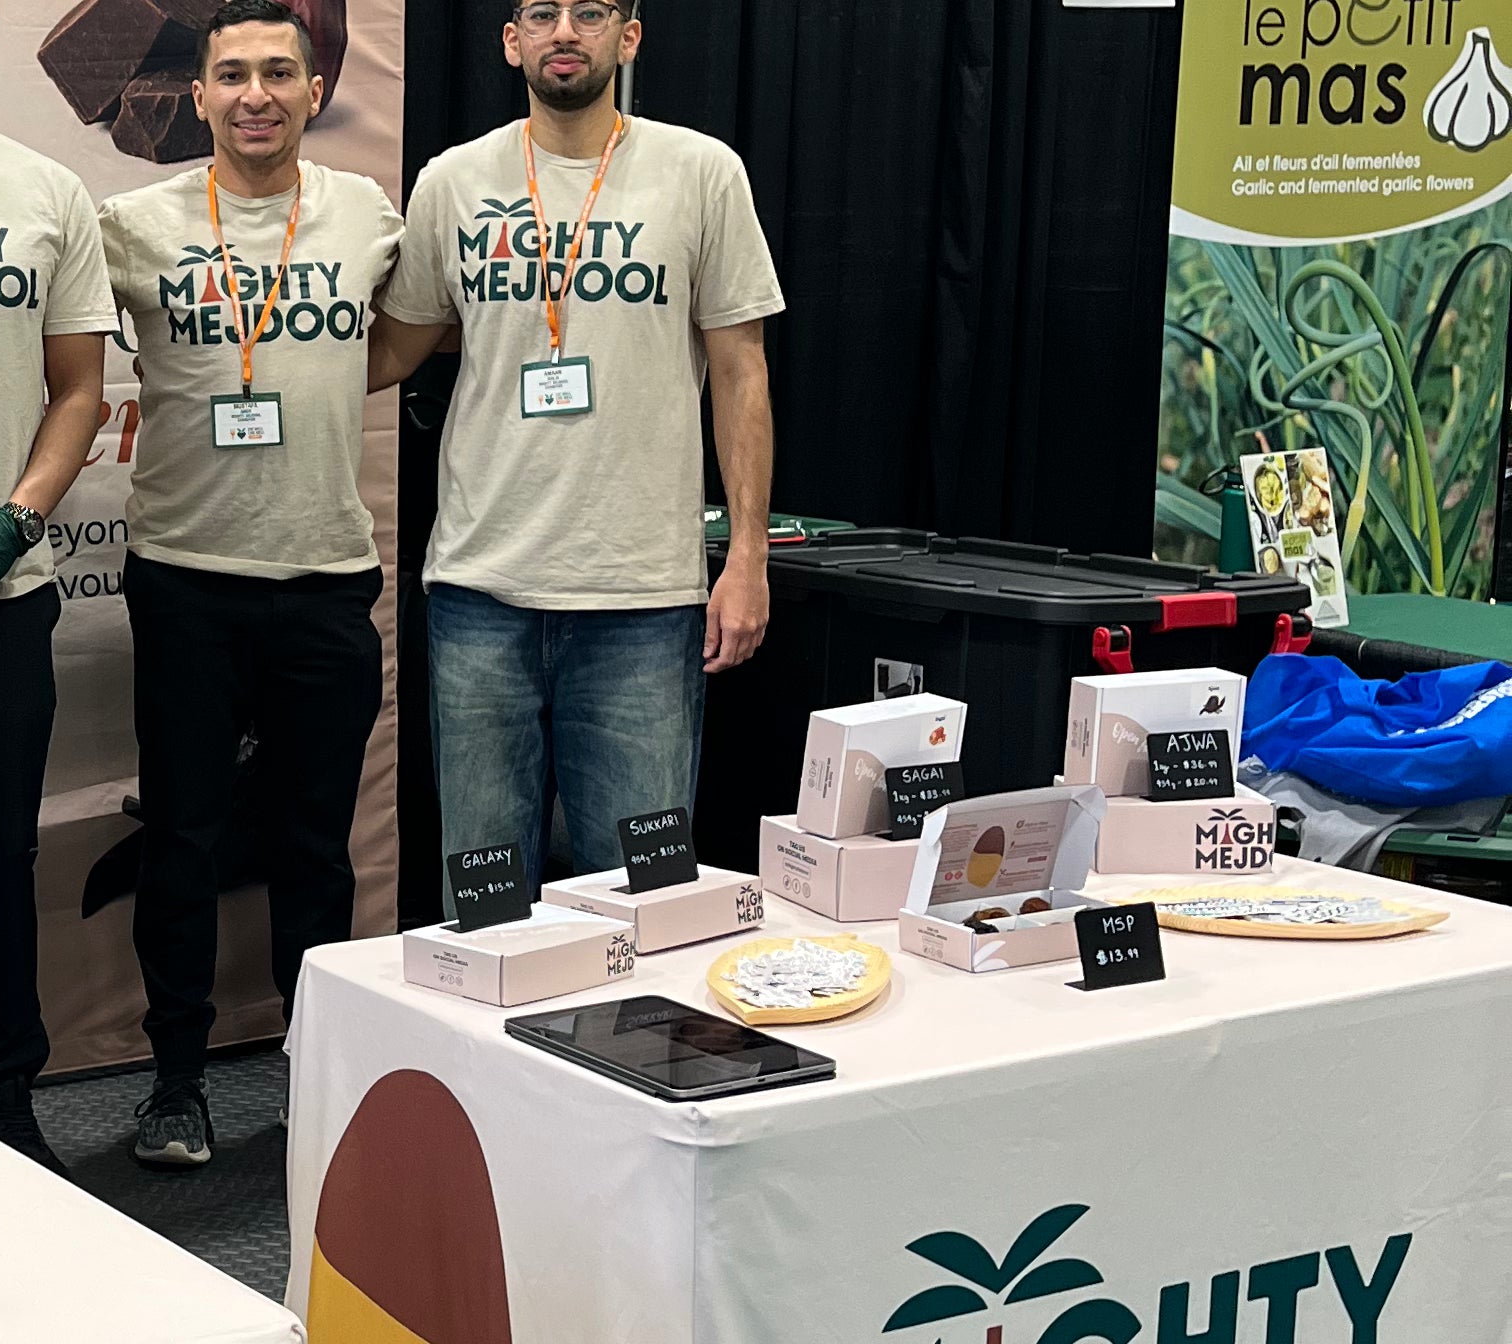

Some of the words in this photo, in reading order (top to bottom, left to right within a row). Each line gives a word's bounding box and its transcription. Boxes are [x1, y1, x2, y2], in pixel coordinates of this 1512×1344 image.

[1239, 63, 1407, 126] mas
[1232, 155, 1253, 172] Ail
[1255, 155, 1270, 172] et
[1273, 154, 1308, 171] fleurs
[1310, 153, 1339, 171] d'ail
[1342, 150, 1421, 170] fermentées
[1231, 177, 1275, 196] Garlic
[1278, 177, 1306, 195] and
[1308, 175, 1379, 194] fermented
[1382, 174, 1423, 197] garlic
[1426, 174, 1474, 191] flowers
[457, 220, 645, 263] MIGHTY
[159, 262, 342, 309] MIGHTY
[460, 261, 669, 305] MEJDOOL
[168, 300, 365, 345] MEJDOOL
[1166, 732, 1218, 753] AJWA
[902, 767, 944, 784] SAGAI
[629, 814, 680, 836] SUKKARI
[462, 848, 512, 869] GALAXY
[1102, 914, 1135, 934] MSP
[1096, 947, 1140, 966] $13.99
